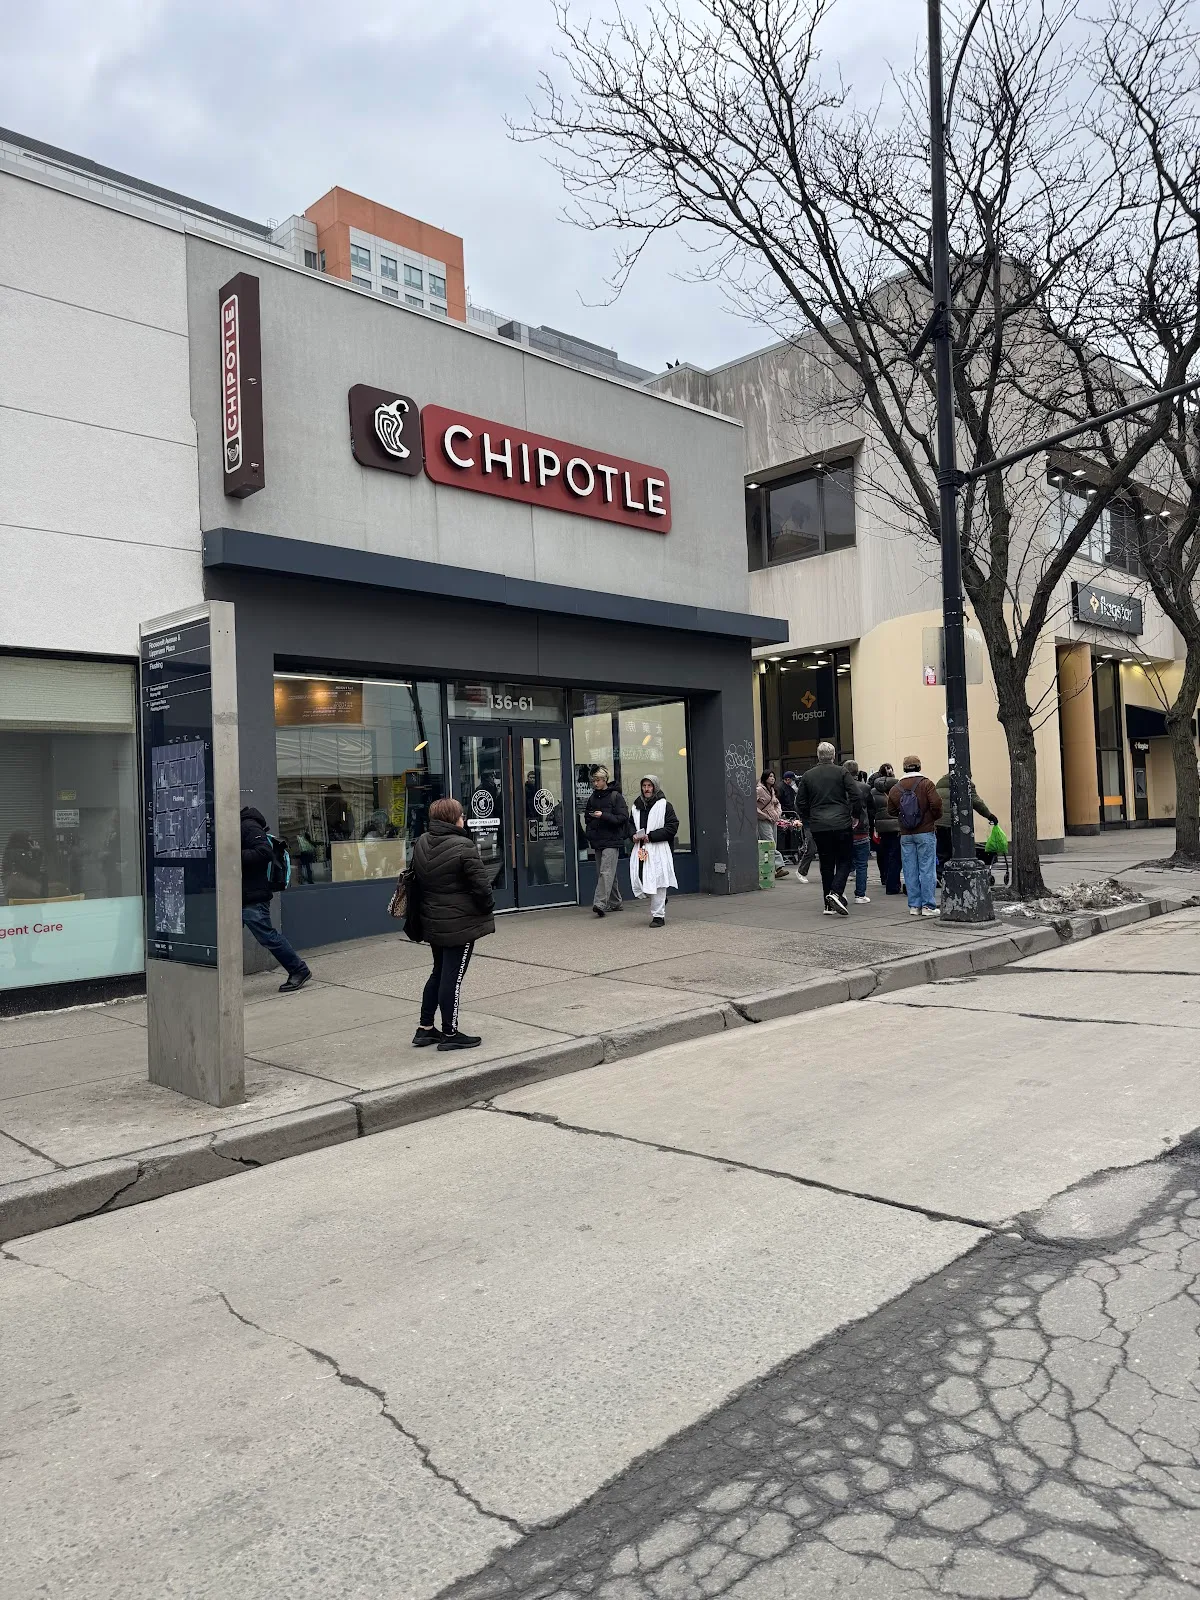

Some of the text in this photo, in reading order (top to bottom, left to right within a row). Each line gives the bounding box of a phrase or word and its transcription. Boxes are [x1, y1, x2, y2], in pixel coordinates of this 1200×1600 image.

[225, 304, 238, 432] CHIPOTLE
[442, 424, 667, 516] CHIPOTLE
[1101, 595, 1133, 622] flagstar
[149, 662, 163, 670] Flushing
[489, 695, 533, 711] 136-61
[792, 710, 826, 722] flagstar
[0, 923, 64, 939] gent Care
